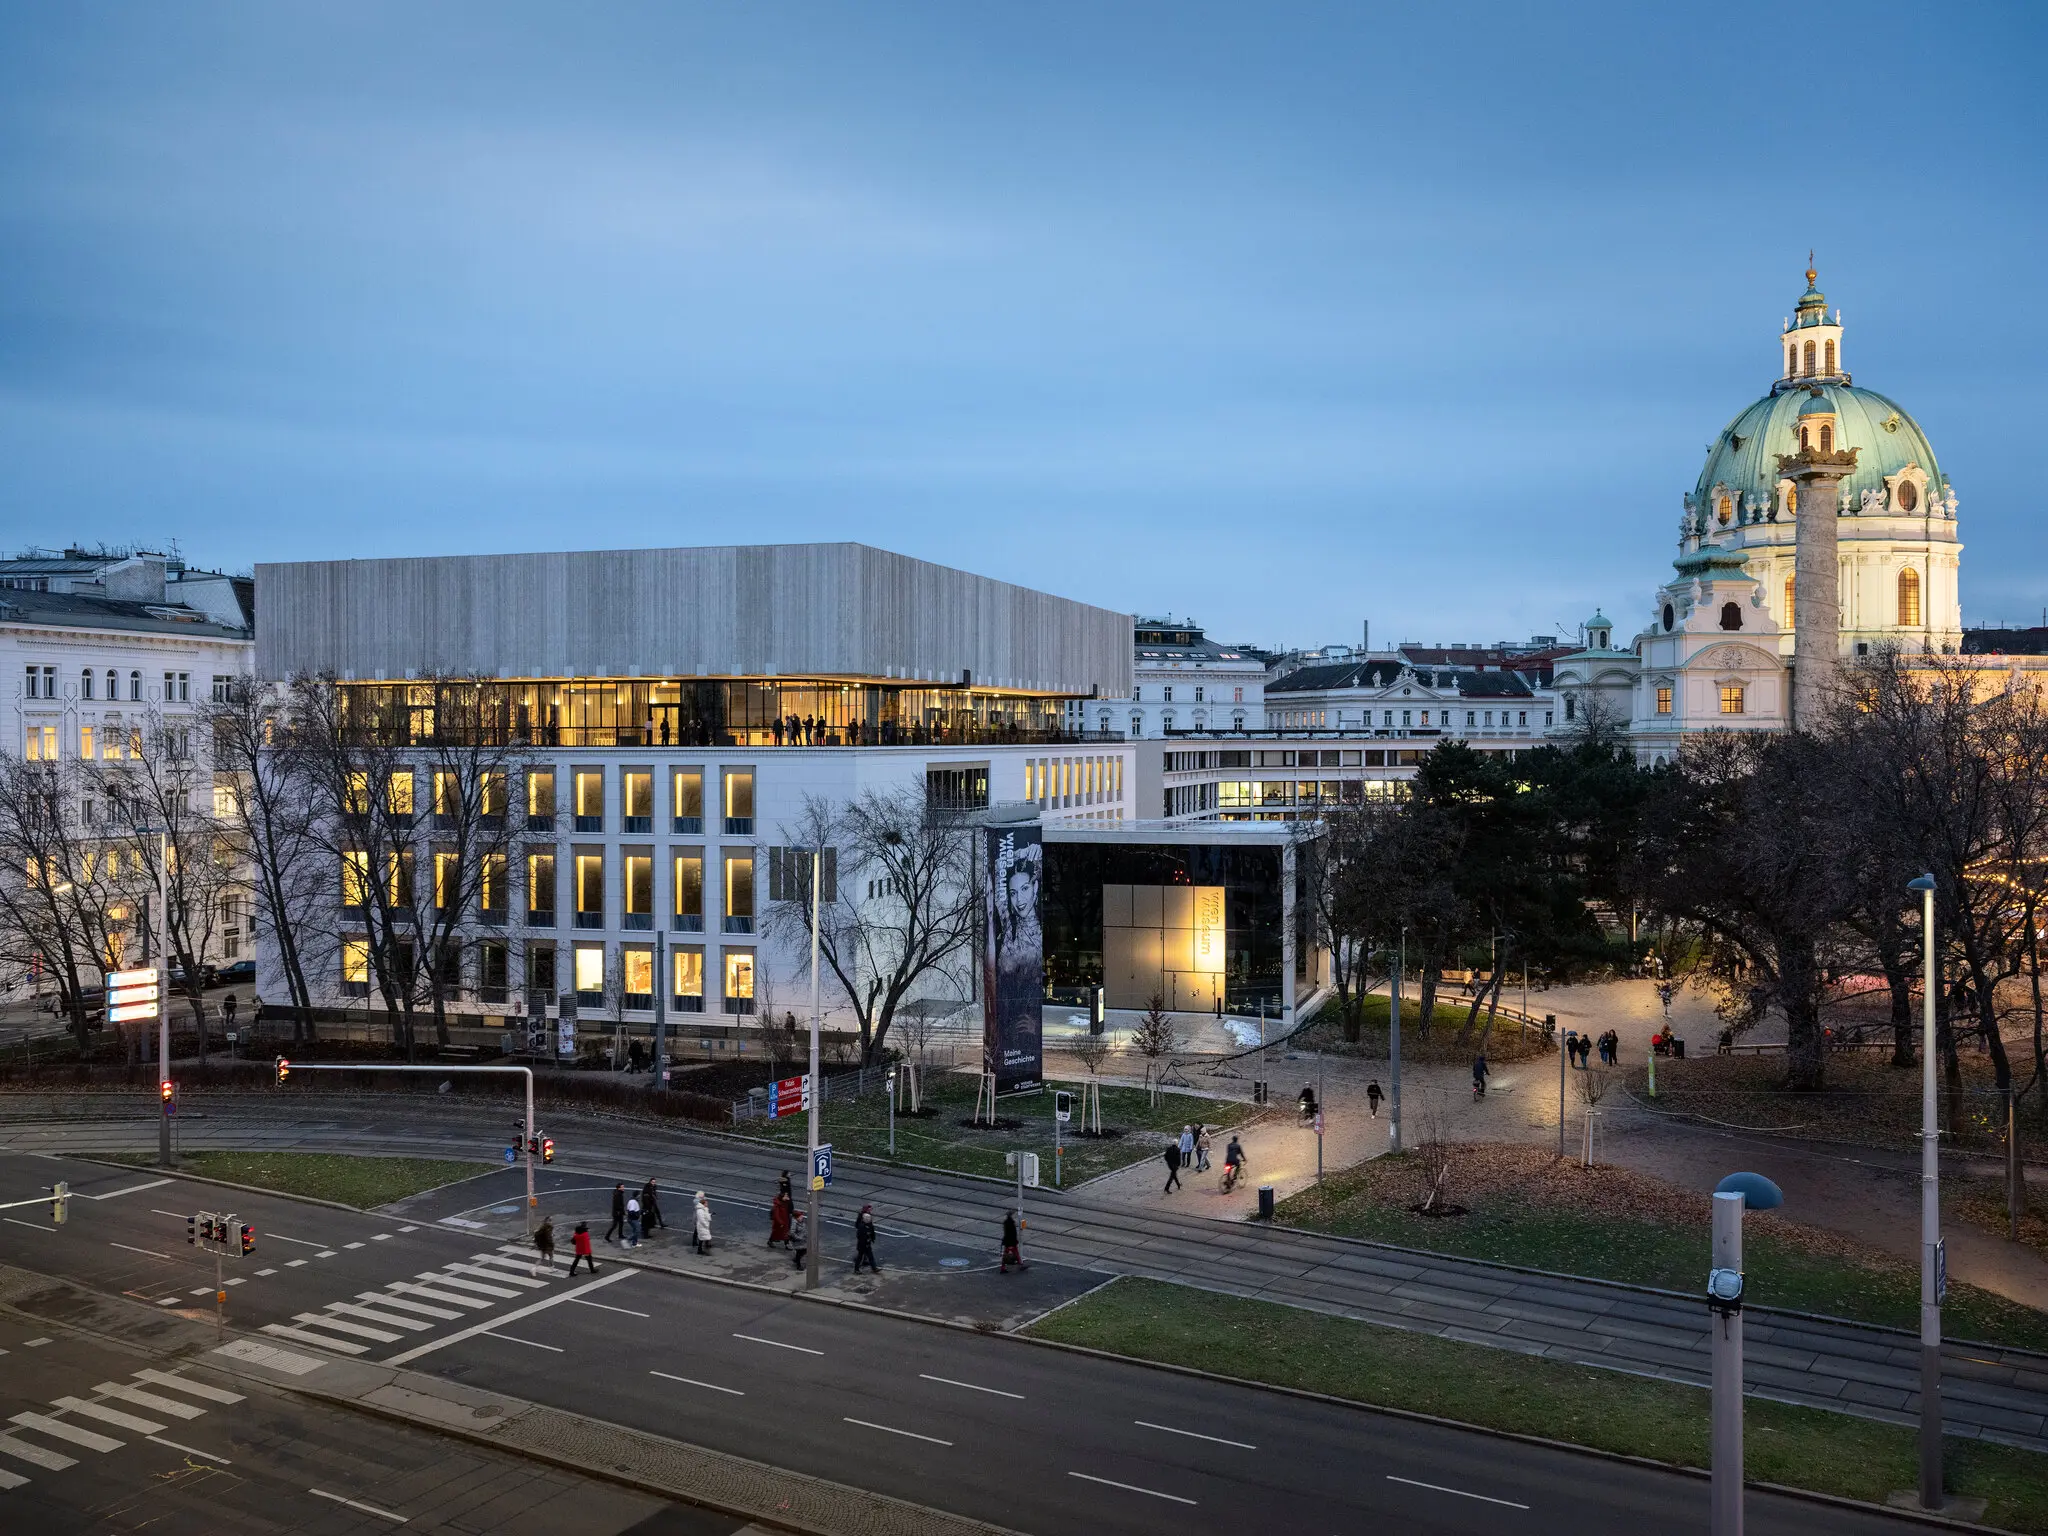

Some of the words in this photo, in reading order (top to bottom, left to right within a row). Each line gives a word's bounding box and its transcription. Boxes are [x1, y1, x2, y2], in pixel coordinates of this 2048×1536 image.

[1003, 1049, 1021, 1057] Meine
[1003, 1055, 1035, 1066] Geschichte
[818, 1158, 827, 1175] P
